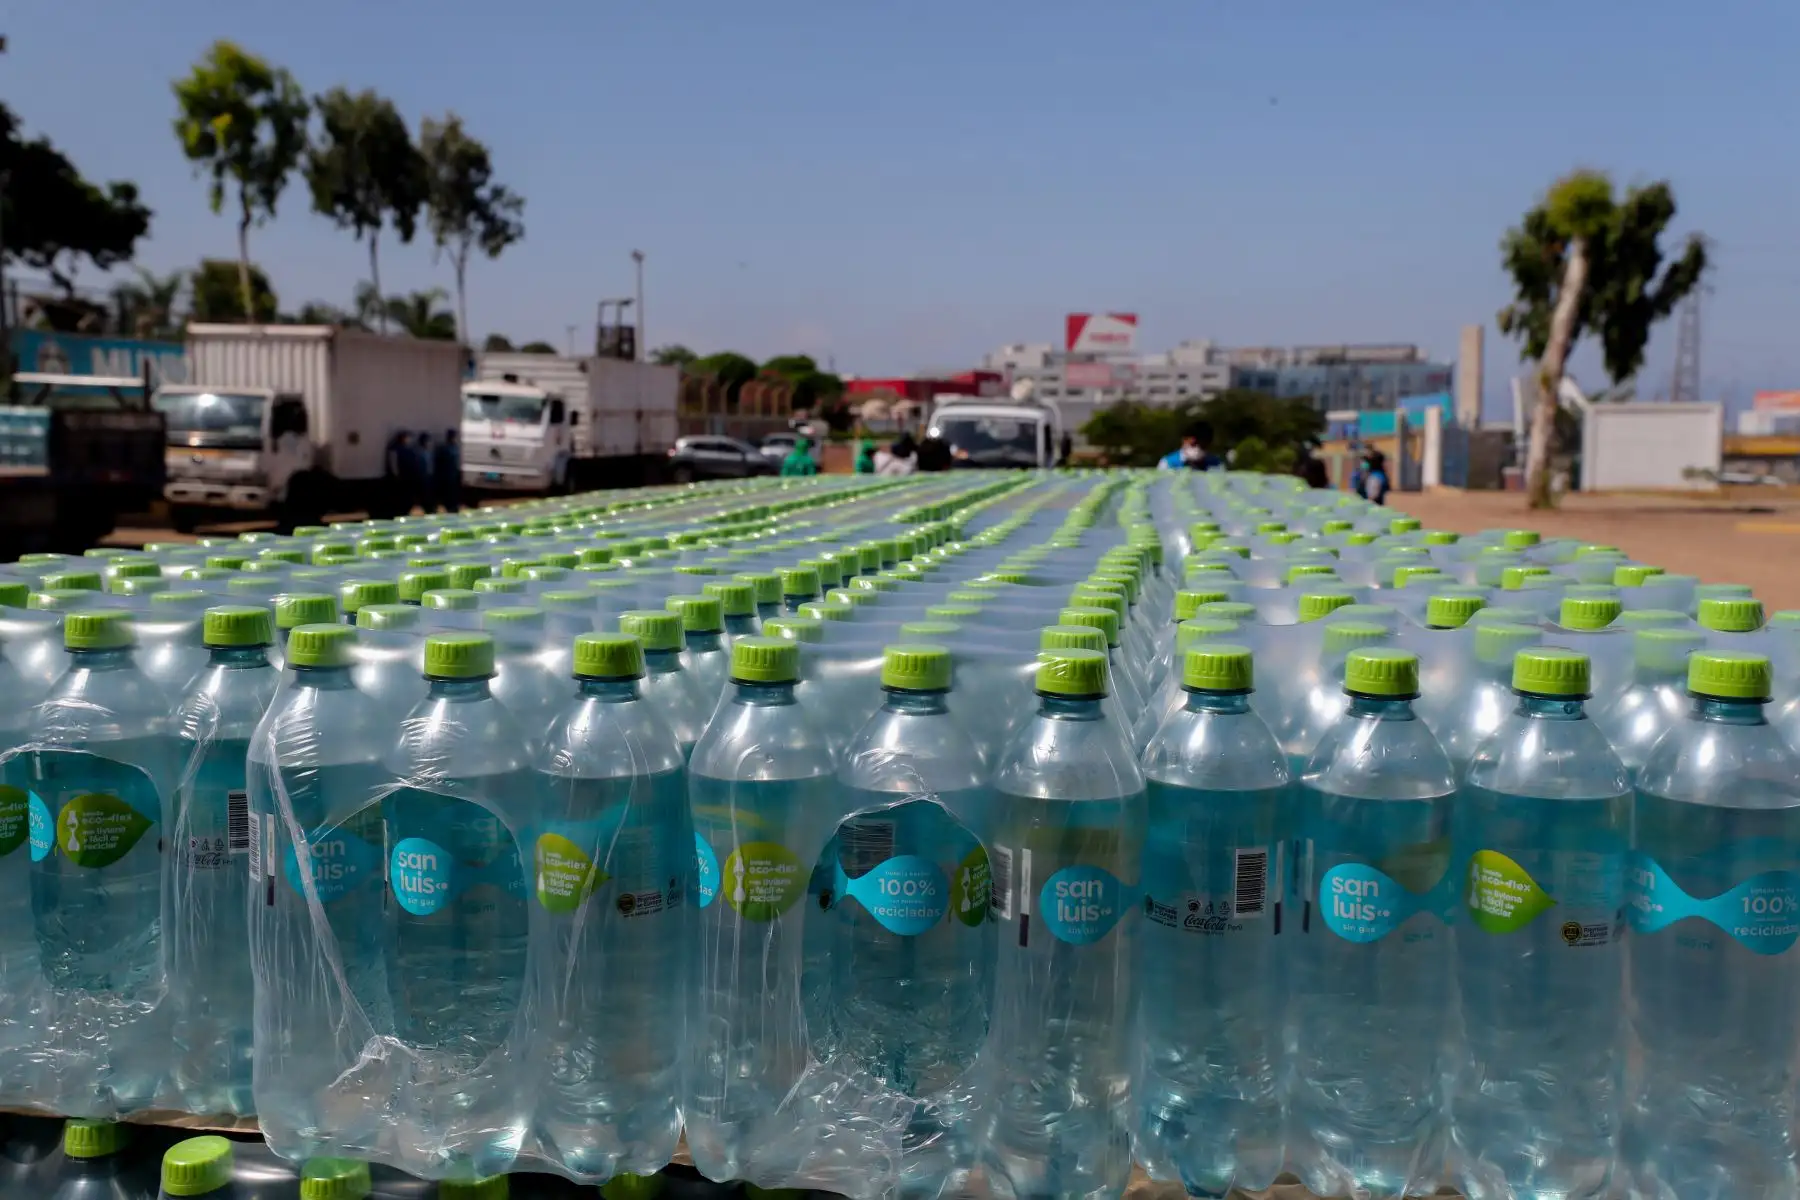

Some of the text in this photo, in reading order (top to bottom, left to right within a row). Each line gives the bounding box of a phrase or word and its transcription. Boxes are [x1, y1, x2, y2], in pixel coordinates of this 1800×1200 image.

[311, 839, 345, 858] an
[398, 851, 437, 871] san
[401, 868, 434, 894] luis
[876, 877, 936, 897] 100%
[1055, 879, 1104, 900] san
[1332, 876, 1379, 898] san
[873, 904, 942, 918] recicladas
[1057, 899, 1100, 923] luis
[1333, 894, 1376, 921] luis
[1741, 895, 1797, 916] 100%
